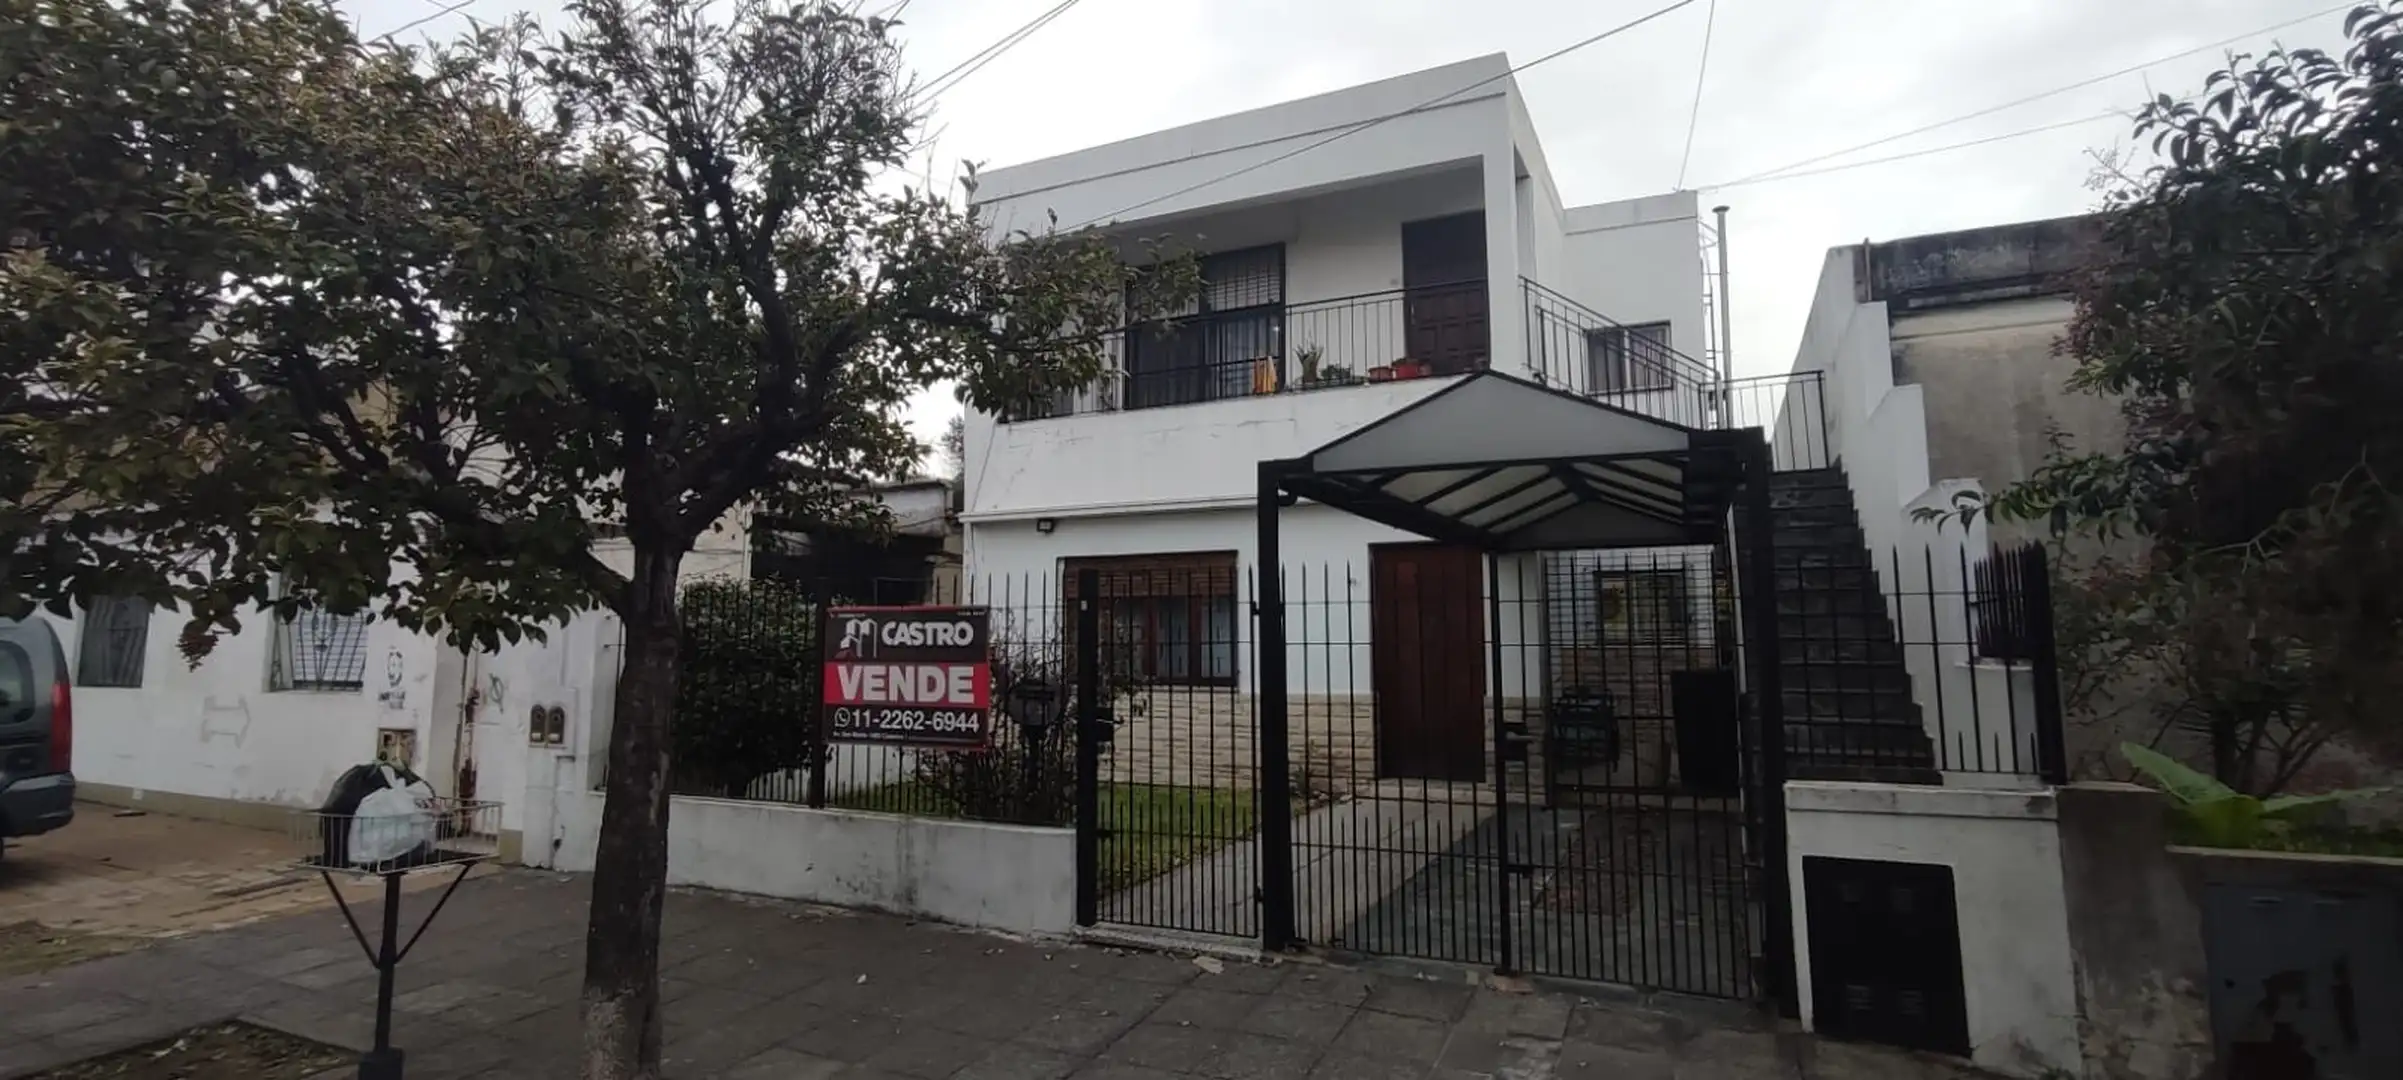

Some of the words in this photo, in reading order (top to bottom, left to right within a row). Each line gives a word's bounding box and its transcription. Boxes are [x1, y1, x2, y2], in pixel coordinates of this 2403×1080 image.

[881, 621, 974, 646] CASTRO
[837, 665, 975, 704] VENDE
[852, 709, 980, 733] 11-2262-6944
